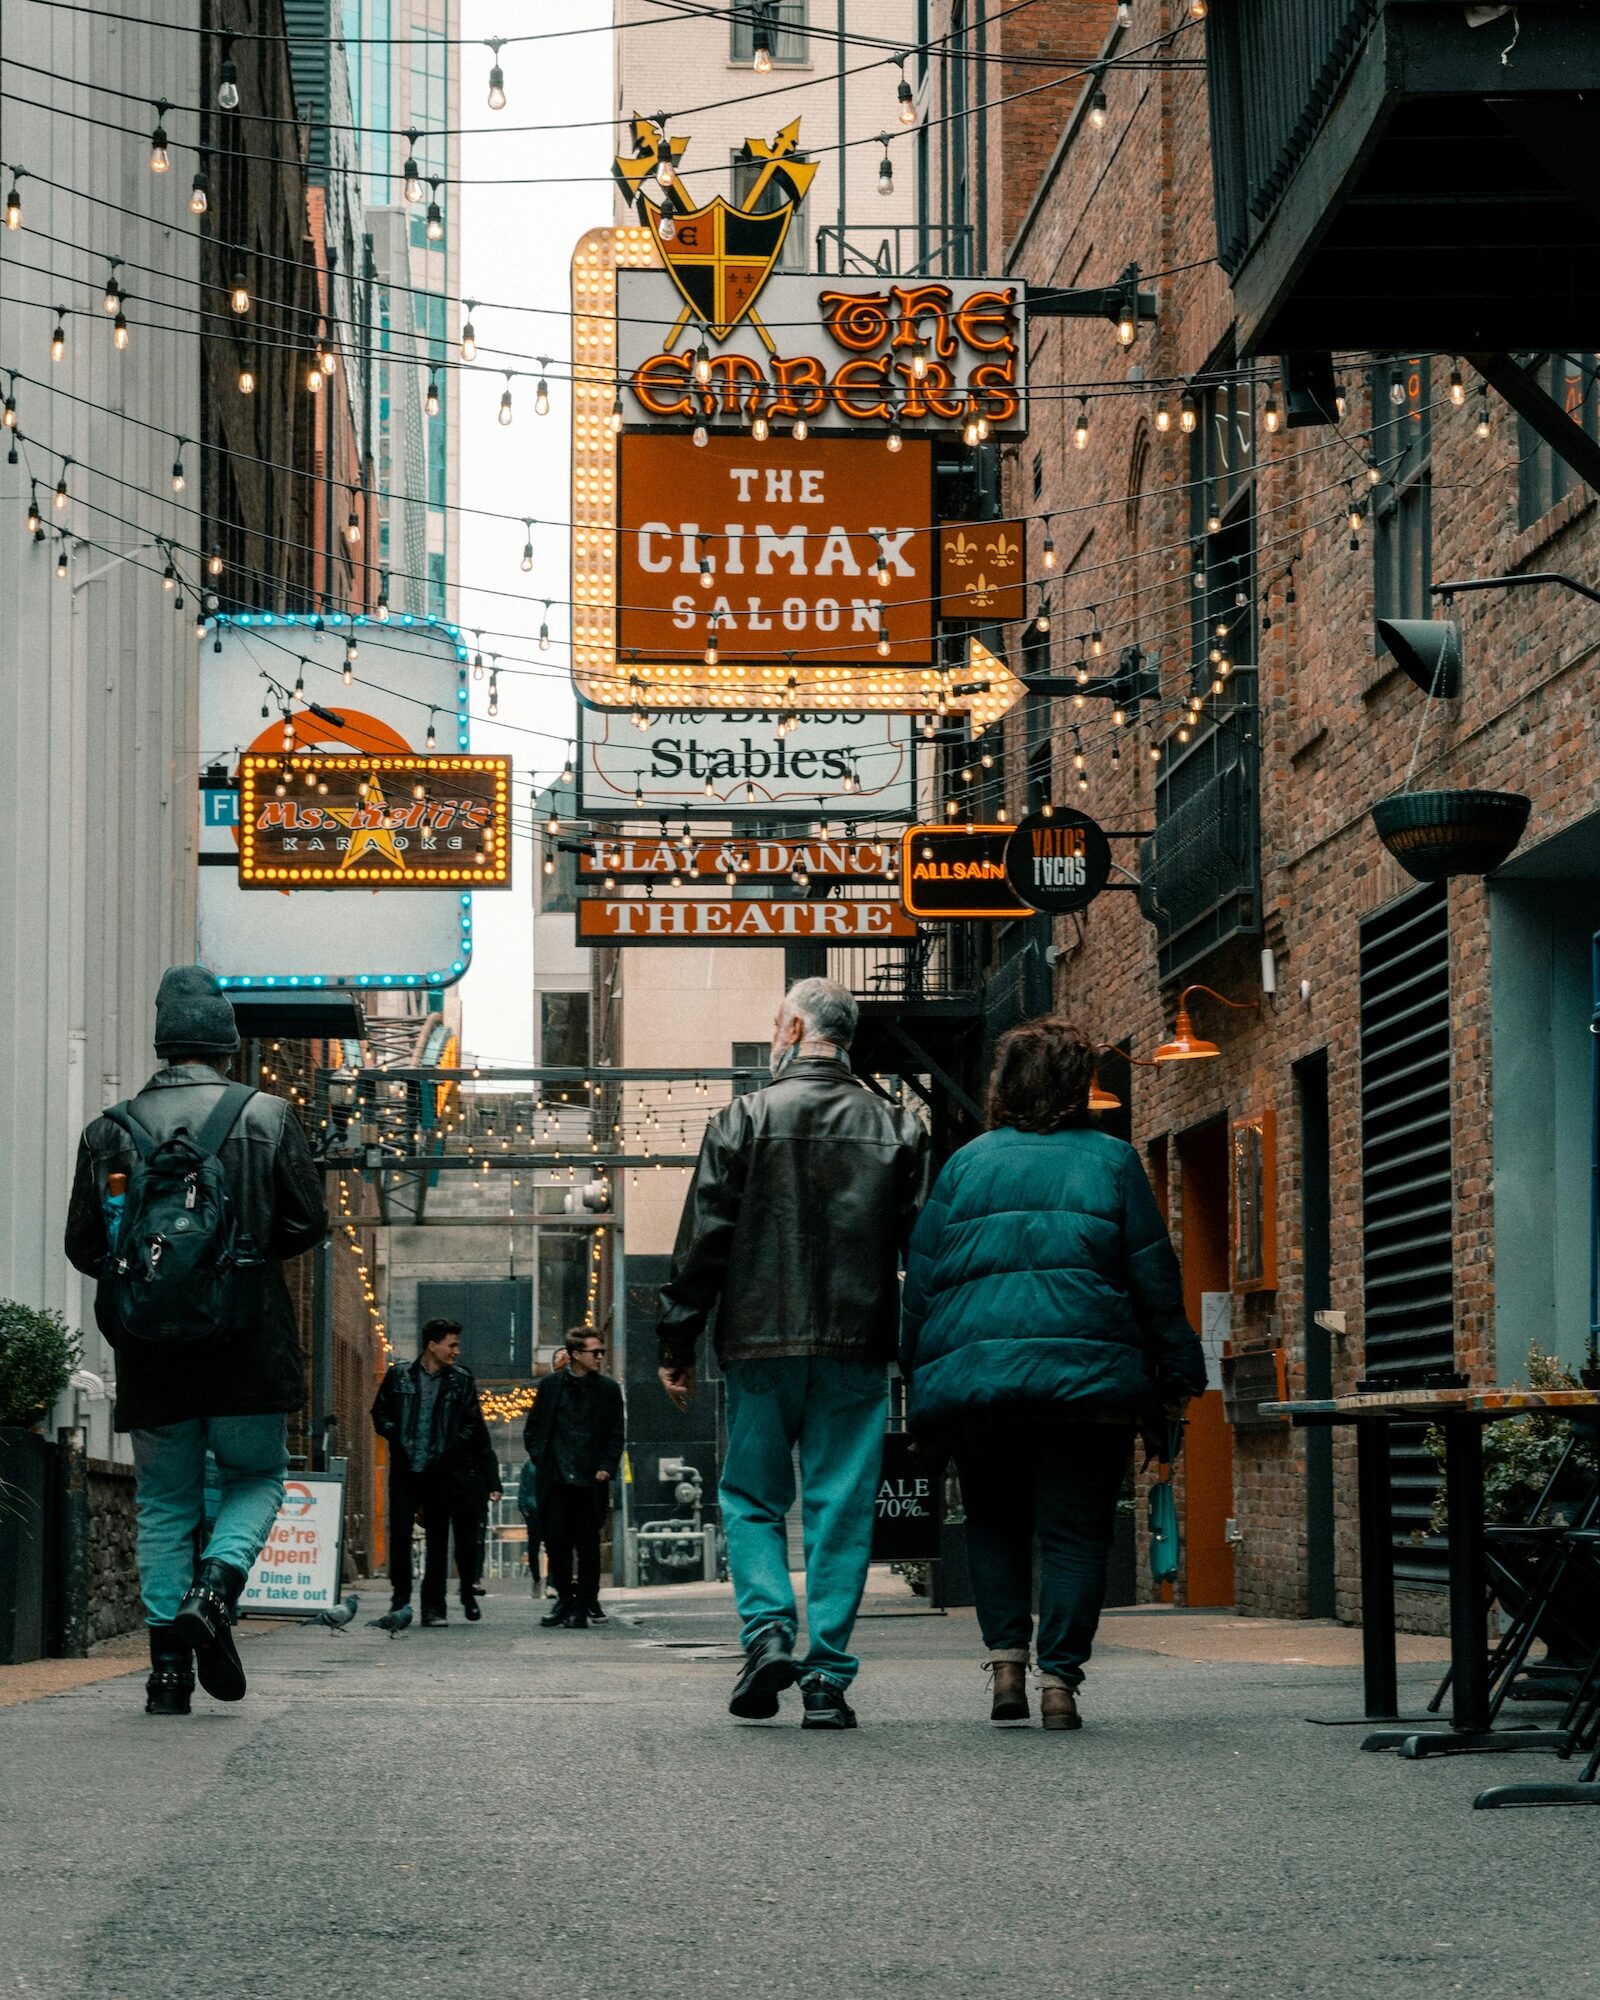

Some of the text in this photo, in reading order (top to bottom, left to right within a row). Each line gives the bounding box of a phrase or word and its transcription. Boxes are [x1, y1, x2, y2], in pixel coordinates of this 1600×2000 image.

[729, 469, 825, 504] THE
[637, 521, 917, 577] CLIMAX
[671, 595, 882, 633] SALOON
[650, 738, 852, 779] Stables
[256, 802, 336, 831] Ms.
[283, 837, 463, 851] KARAOKE
[1031, 828, 1086, 857] VATOS
[1032, 857, 1087, 886] TACOS
[605, 904, 893, 934] THEATRE
[875, 1498, 930, 1517] 70%
[261, 1546, 318, 1566] Open!
[260, 1571, 311, 1584] Dine in
[246, 1587, 328, 1600] or take out
